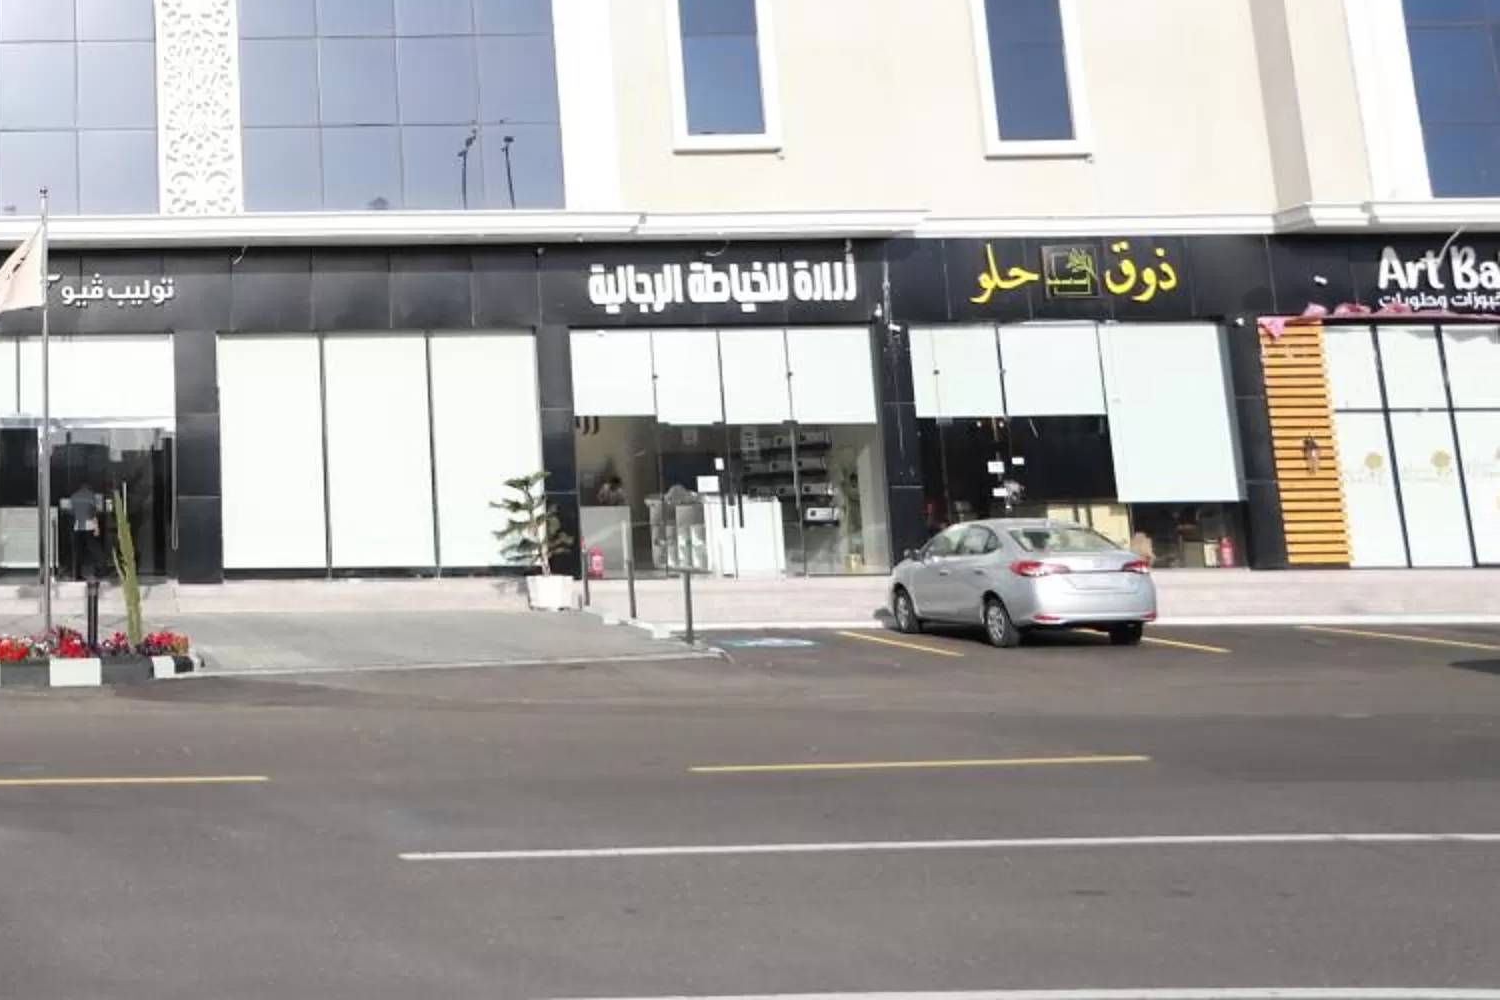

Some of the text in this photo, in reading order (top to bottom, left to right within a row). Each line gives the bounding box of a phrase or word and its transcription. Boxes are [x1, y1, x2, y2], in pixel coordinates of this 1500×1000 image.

[107, 277, 175, 308] توليب
[588, 262, 685, 315] الرجالية
[688, 260, 790, 314] للخياطة
[969, 240, 1179, 304] ذوق حلو
[1378, 244, 1500, 290] Art Ba
